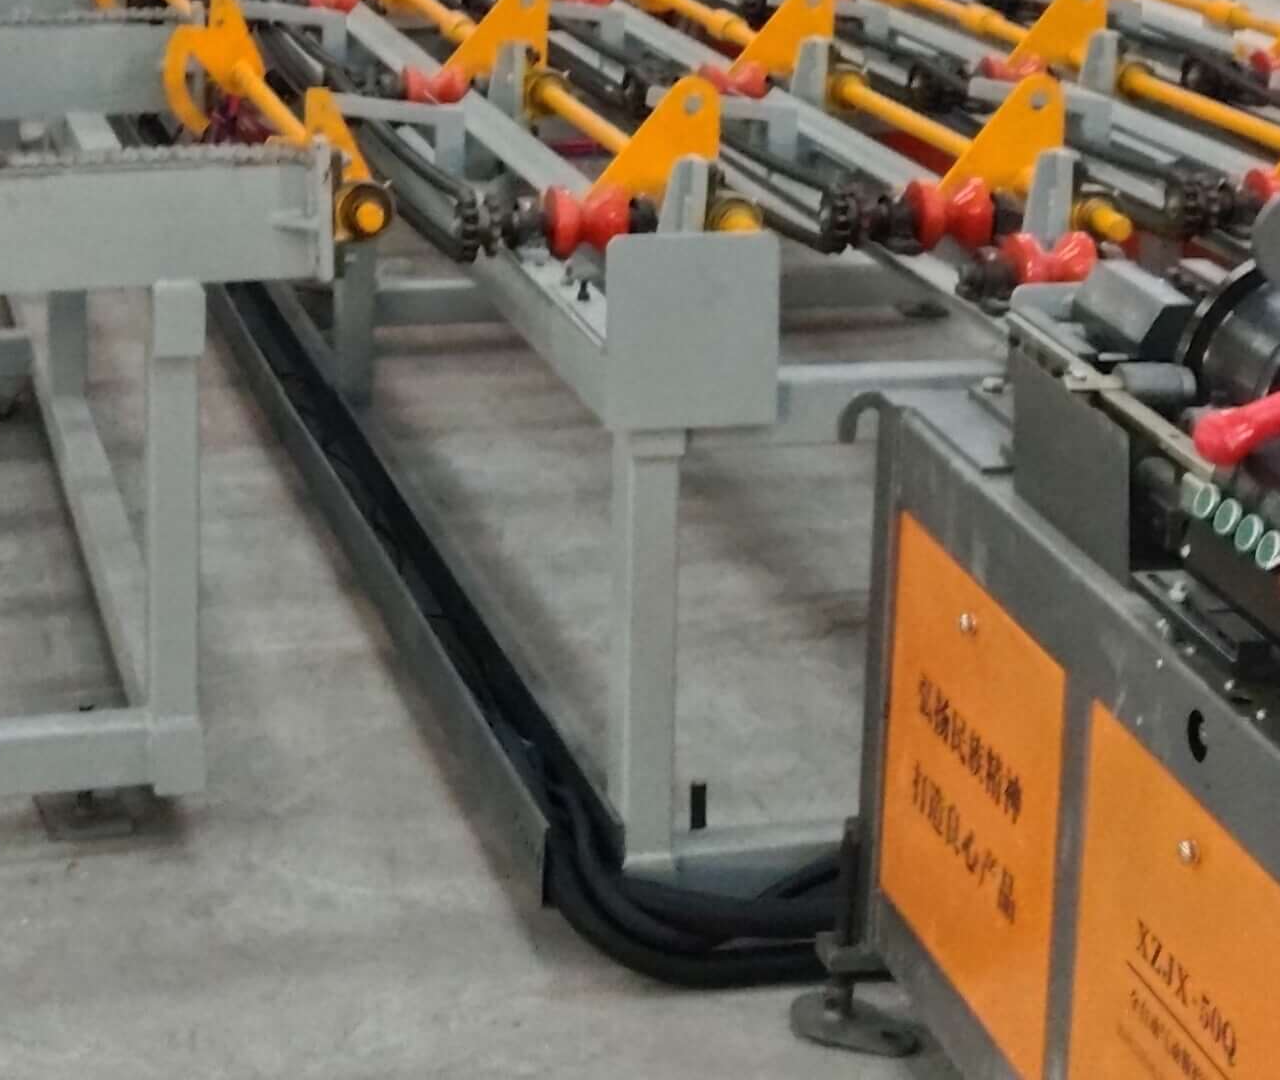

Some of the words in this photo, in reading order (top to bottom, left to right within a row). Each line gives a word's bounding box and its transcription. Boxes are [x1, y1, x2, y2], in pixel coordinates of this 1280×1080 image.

[918, 672, 1022, 825] 弘扬民族精神
